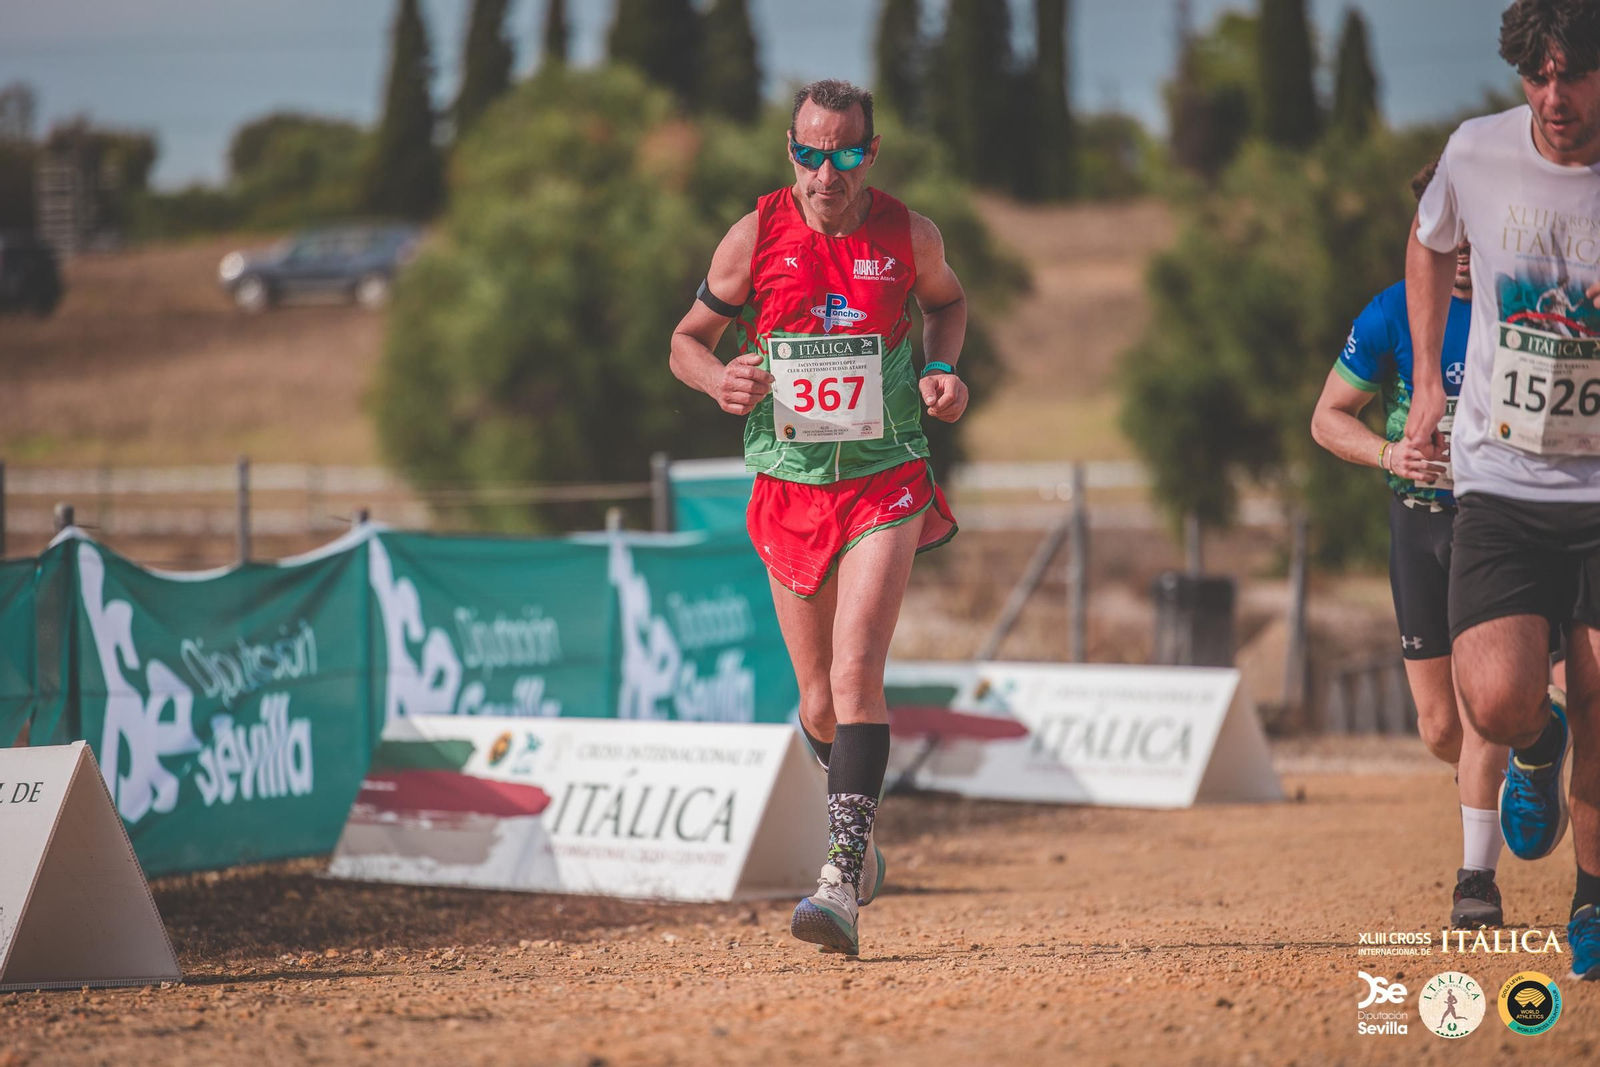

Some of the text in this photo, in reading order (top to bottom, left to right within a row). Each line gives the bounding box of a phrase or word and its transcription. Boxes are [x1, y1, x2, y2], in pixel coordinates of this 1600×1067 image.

[853, 259, 880, 276] ATARFE
[825, 293, 859, 319] Poncho
[799, 341, 854, 356] ITÁLICA
[793, 376, 865, 412] 367
[1502, 369, 1600, 418] 1526
[194, 691, 314, 806] Sevilla
[9, 781, 44, 803] DE
[551, 766, 737, 845] ITÁLICA
